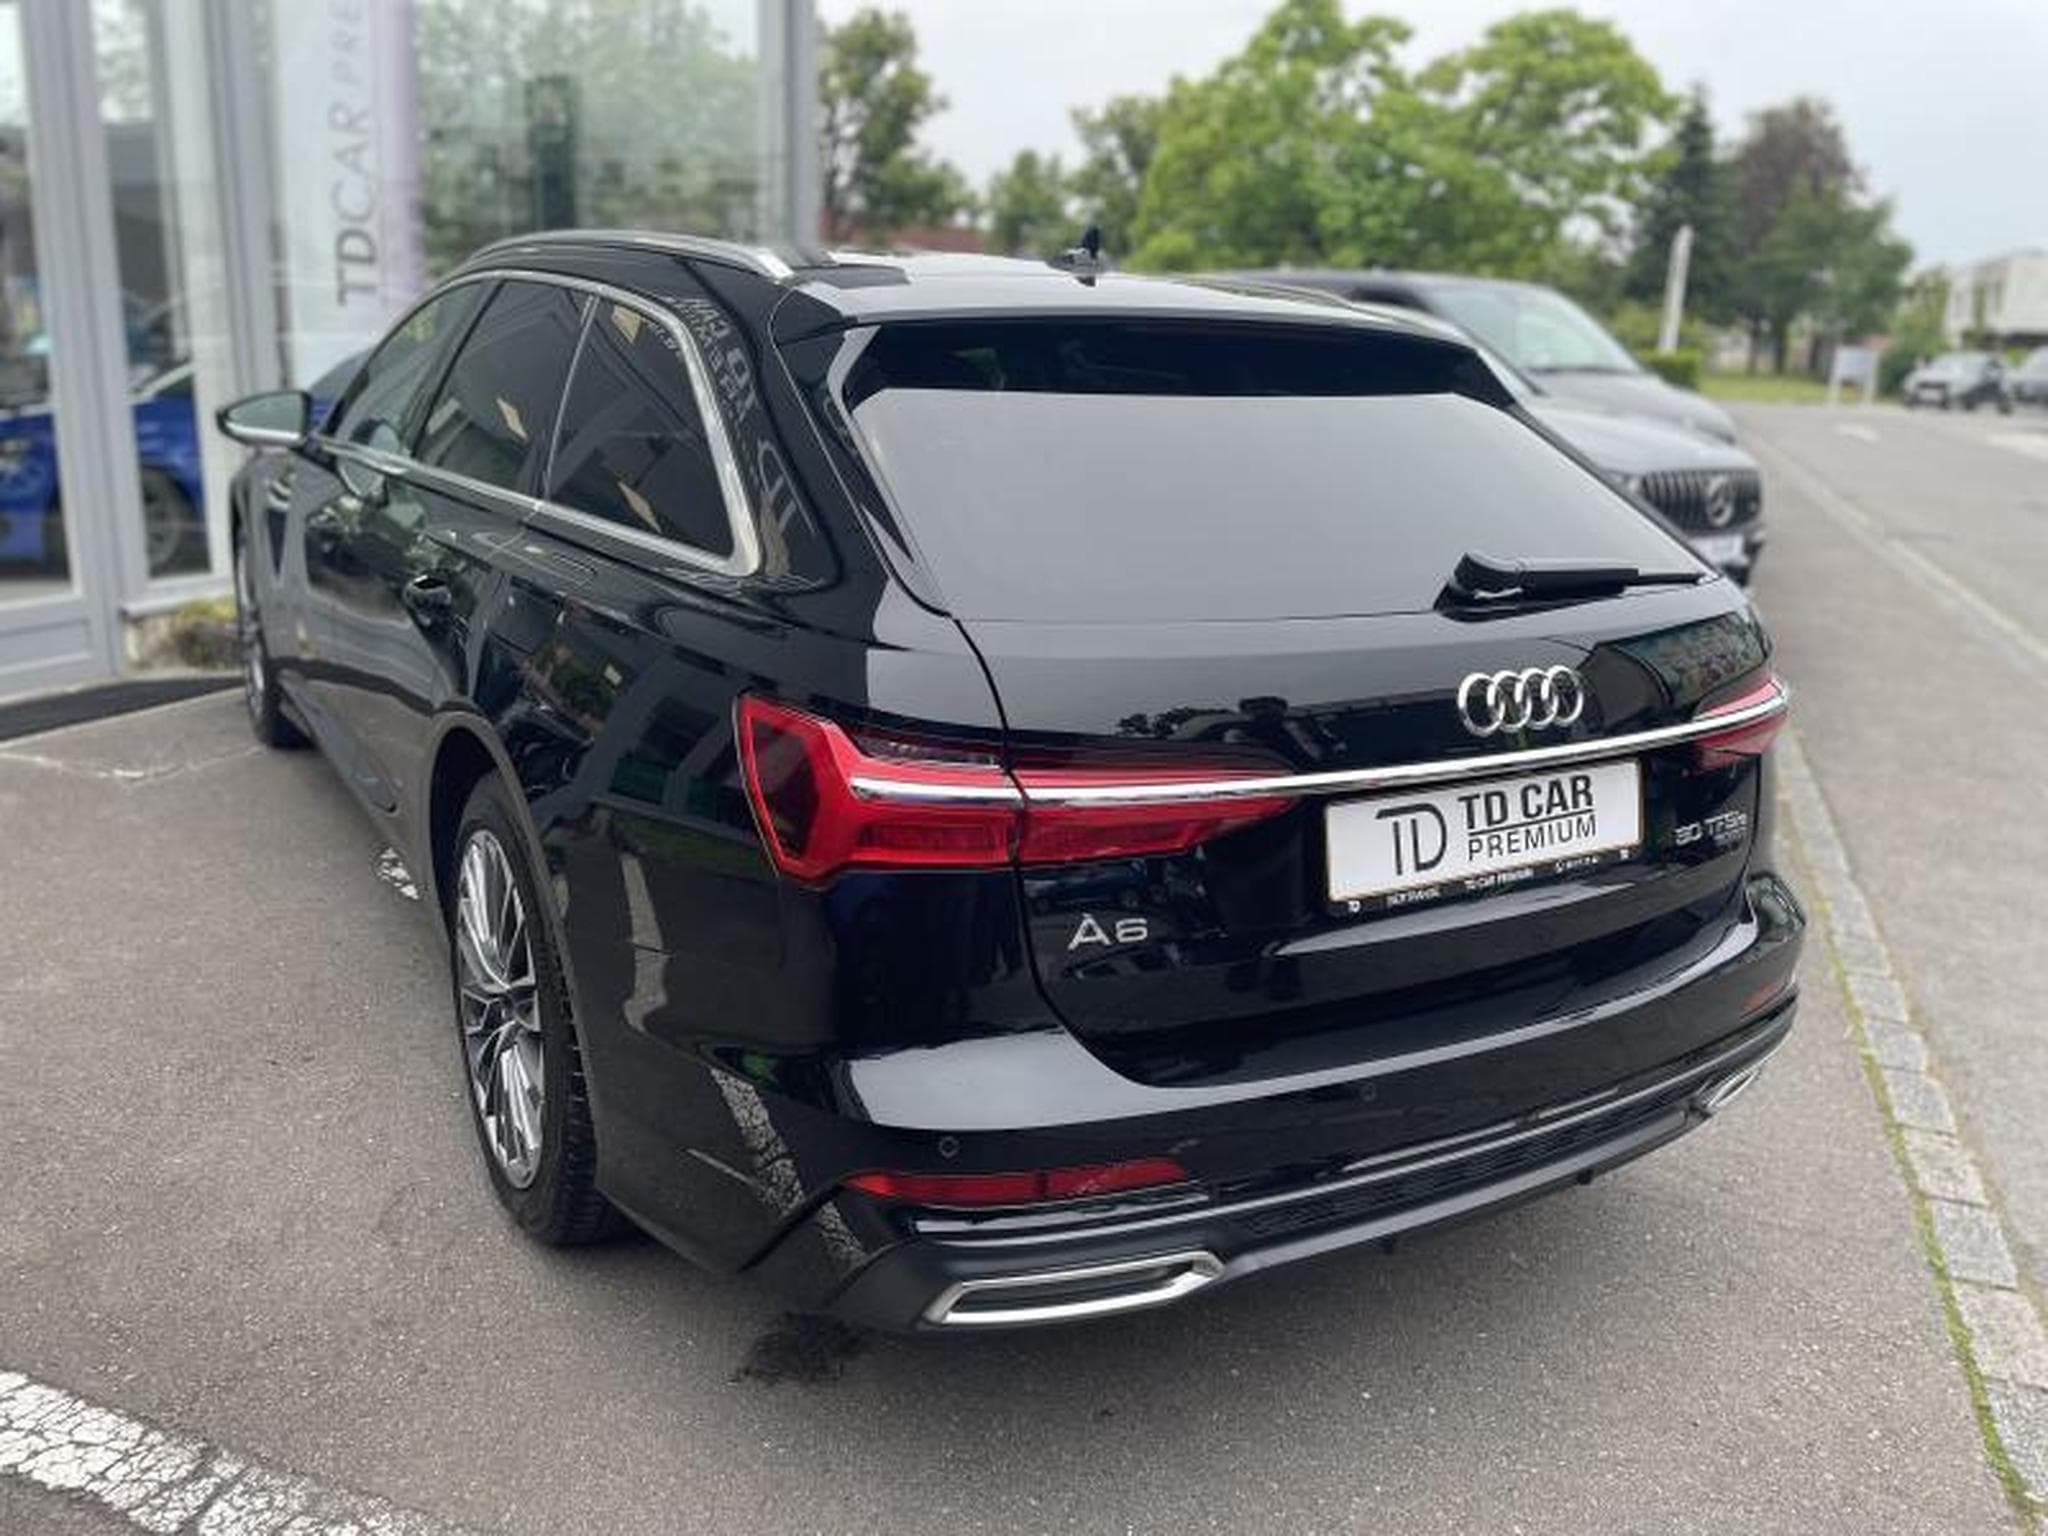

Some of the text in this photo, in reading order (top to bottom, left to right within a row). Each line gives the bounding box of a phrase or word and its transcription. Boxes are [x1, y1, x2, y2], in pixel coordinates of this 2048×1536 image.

[1458, 775, 1593, 830] TD CAR
[1468, 814, 1596, 861] PREMIUM
[1067, 913, 1148, 951] A6
